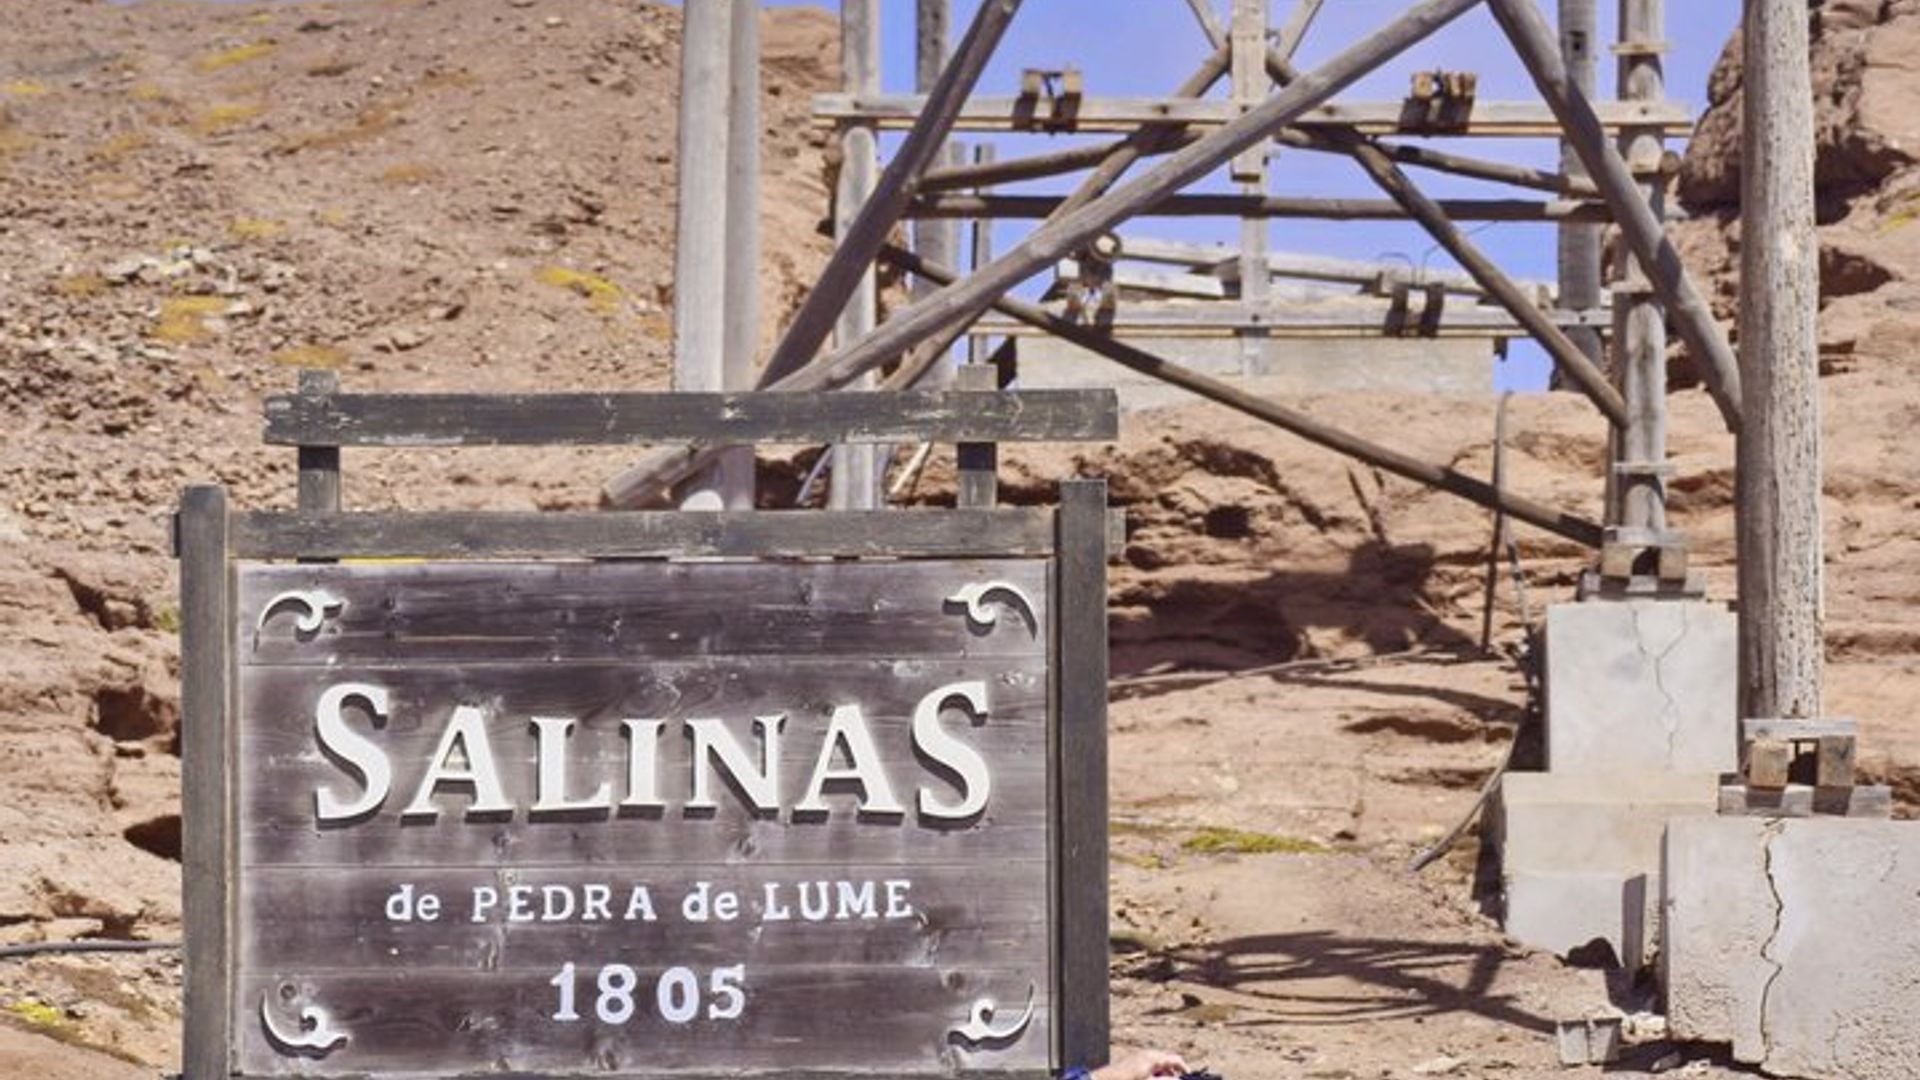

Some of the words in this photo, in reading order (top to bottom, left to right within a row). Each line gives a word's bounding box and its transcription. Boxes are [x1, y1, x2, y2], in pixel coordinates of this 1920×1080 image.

[314, 680, 991, 822] SALINAS
[385, 884, 441, 921] de
[471, 885, 658, 922] PEDRA
[682, 882, 739, 921] de
[763, 880, 914, 921] LUME
[549, 962, 747, 1024] 1805
